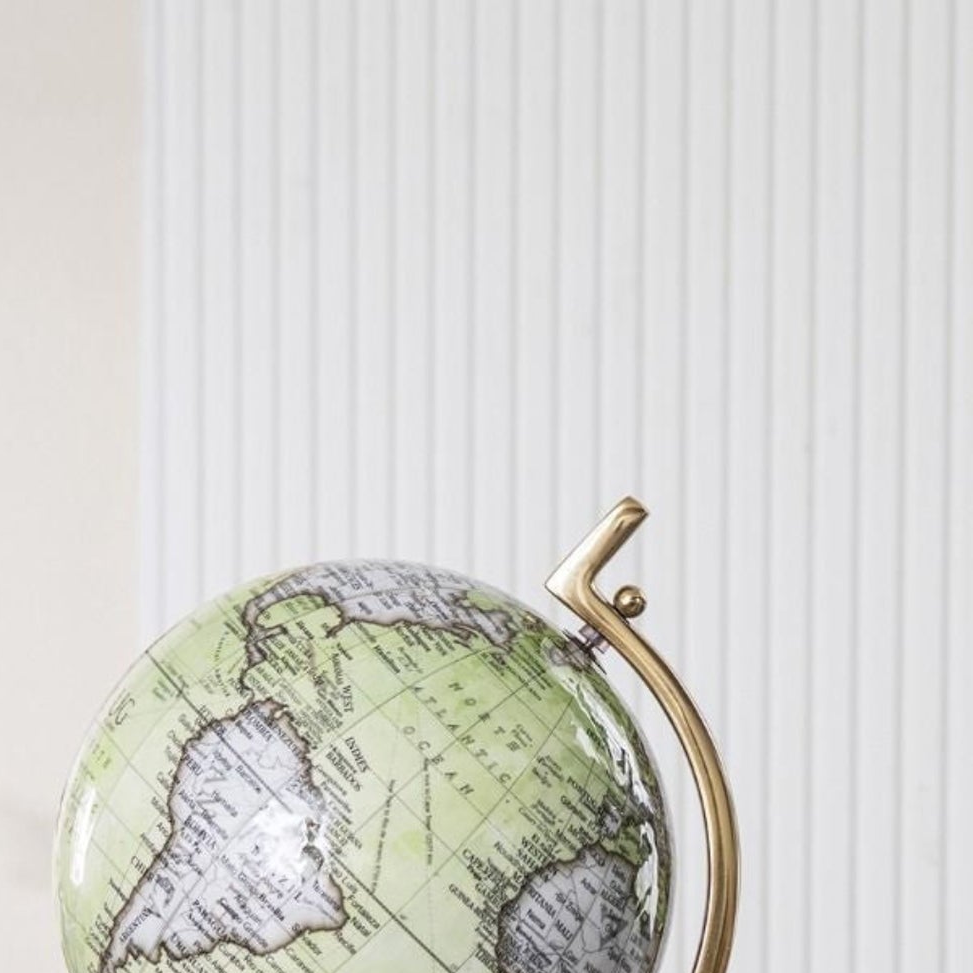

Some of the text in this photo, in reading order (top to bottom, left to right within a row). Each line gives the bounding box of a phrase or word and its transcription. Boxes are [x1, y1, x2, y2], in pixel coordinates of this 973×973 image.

[409, 682, 513, 785] ATLANTIC
[400, 722, 476, 797] OCEAN
[344, 893, 382, 930] Fortaleza
[348, 916, 371, 939] Natal
[332, 929, 359, 956] Recife
